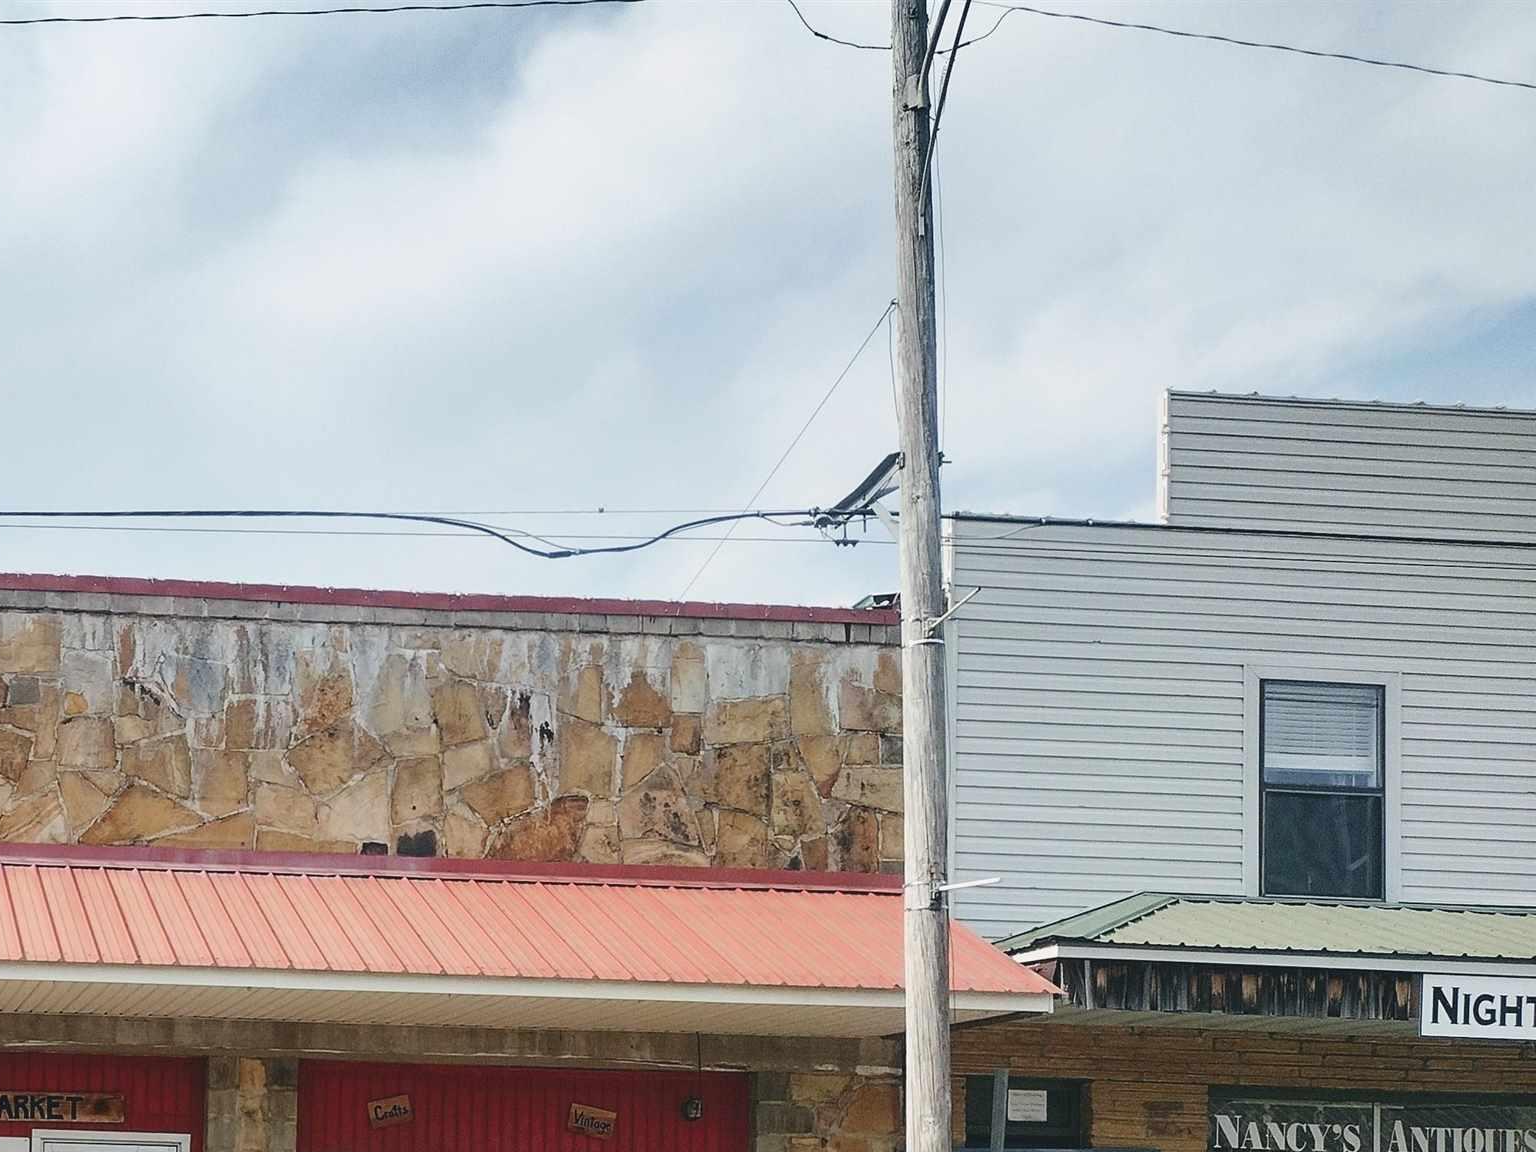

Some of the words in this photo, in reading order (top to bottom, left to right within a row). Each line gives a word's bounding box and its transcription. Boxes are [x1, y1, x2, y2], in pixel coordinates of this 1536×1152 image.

[374, 1104, 409, 1121] Crafts
[574, 1108, 611, 1135] Vintage
[1214, 1114, 1362, 1152] NANCY'S
